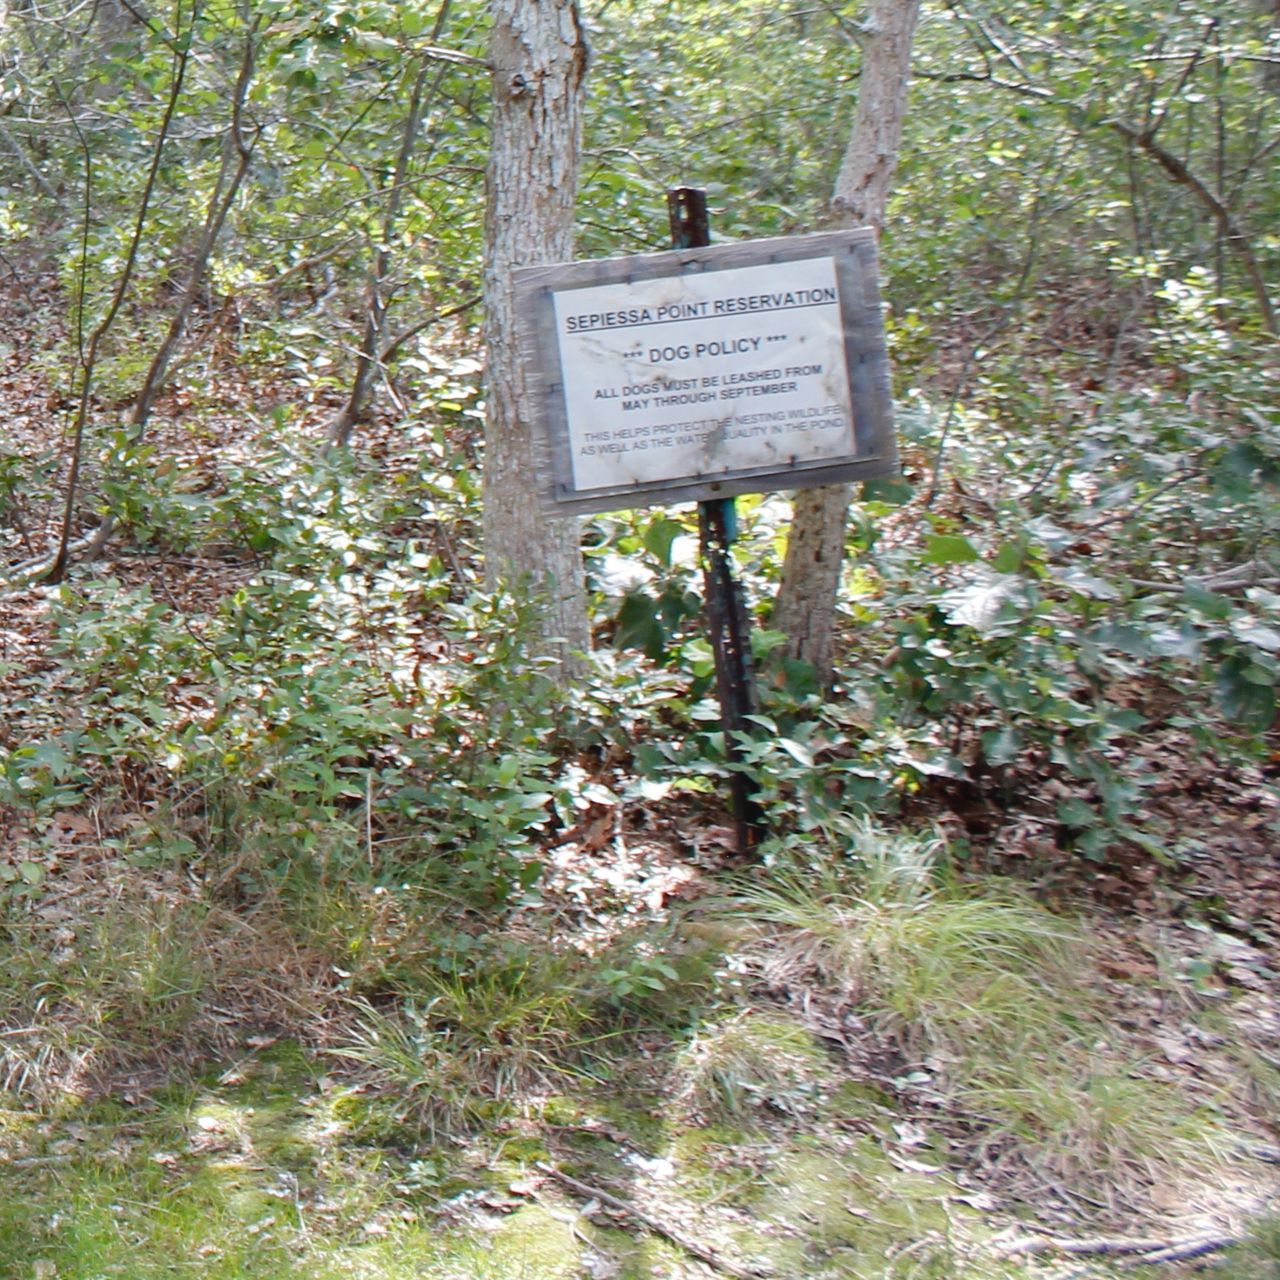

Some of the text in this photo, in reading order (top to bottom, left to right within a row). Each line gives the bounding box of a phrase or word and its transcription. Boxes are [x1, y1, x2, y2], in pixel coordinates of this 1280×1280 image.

[566, 287, 837, 330] SEPIESSA POINT RESERVATION
[649, 337, 760, 363] DOG POLICY
[594, 364, 823, 400] ALL DOGS MUST BE LEASHED FROM
[622, 381, 798, 411] MAY THROUGH SEPTEMBER
[580, 443, 597, 455] AS
[597, 440, 628, 454] WELL
[632, 438, 648, 450] AS
[651, 435, 673, 448] THE
[770, 424, 783, 436] IN
[786, 422, 809, 435] THE
[584, 405, 841, 442] THIS HELPS PROTECT NESTING WILDLIFE
